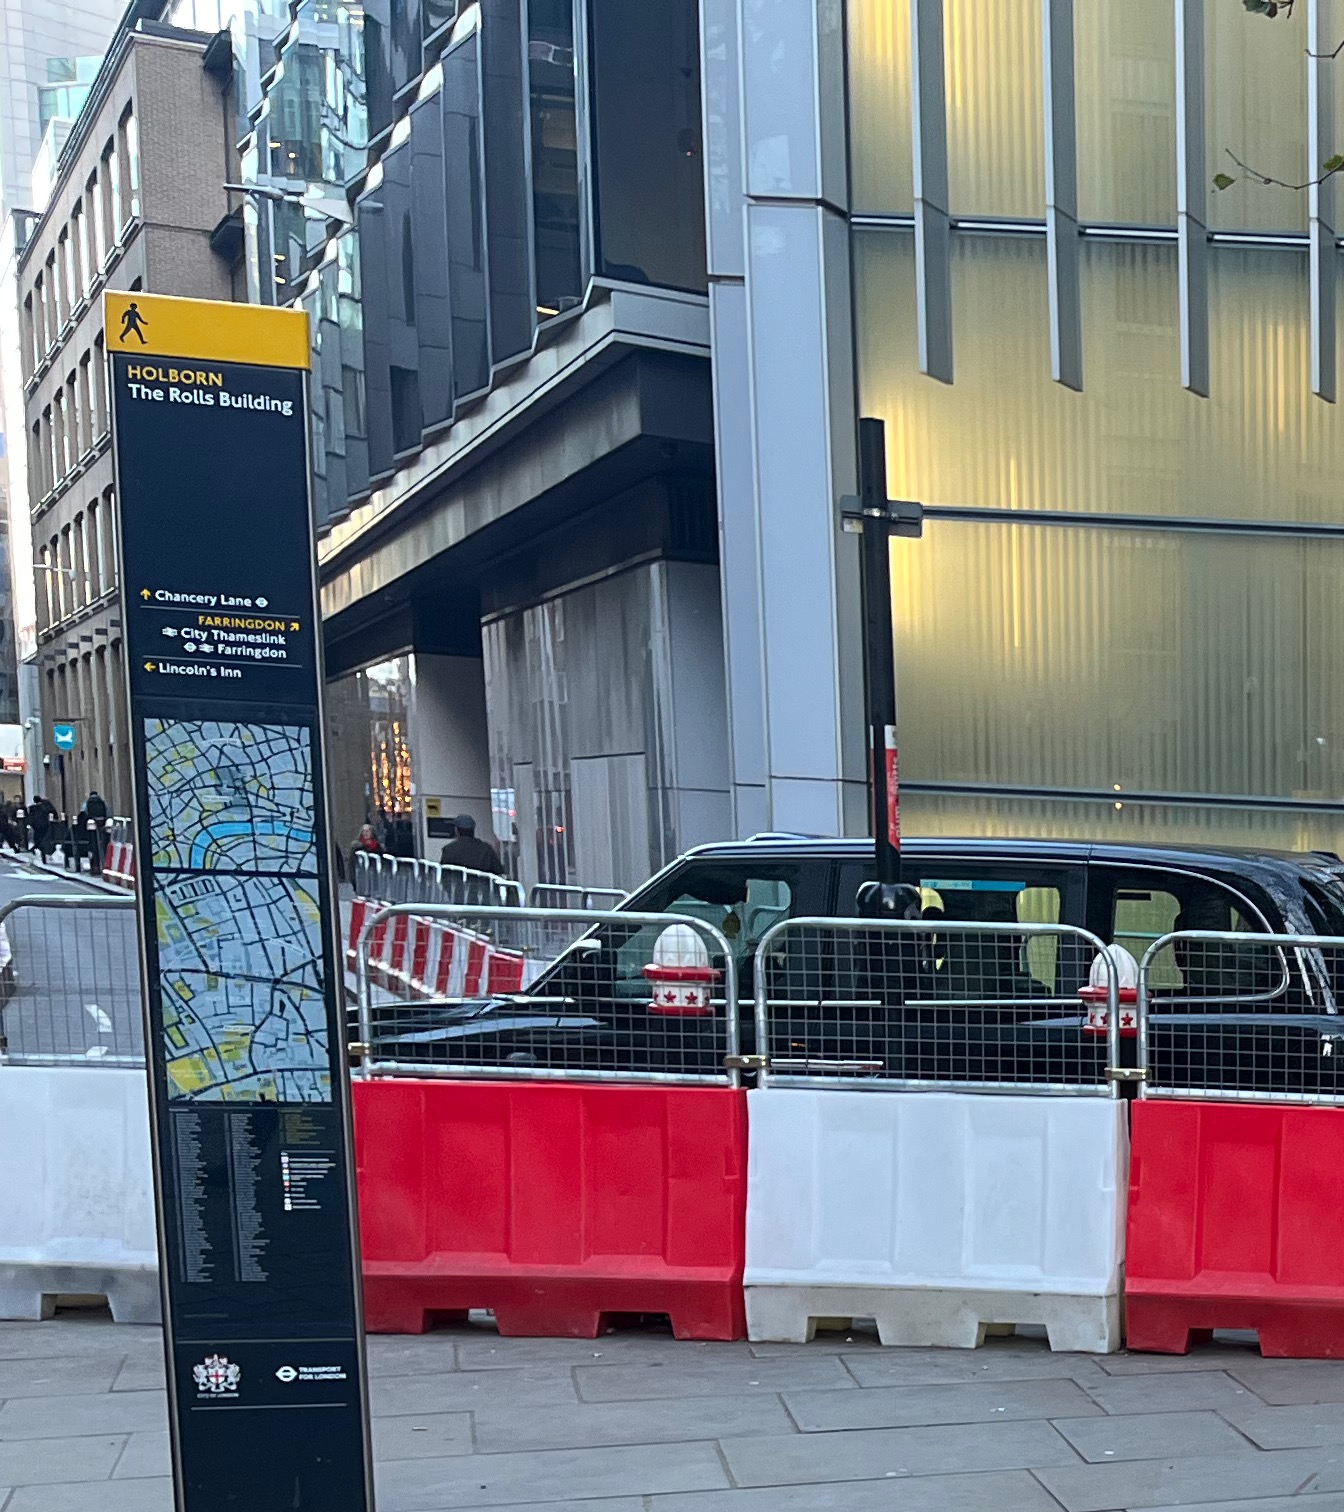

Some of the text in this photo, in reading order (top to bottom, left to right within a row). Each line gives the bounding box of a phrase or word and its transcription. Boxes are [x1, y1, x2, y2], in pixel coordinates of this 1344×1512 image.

[127, 364, 223, 387] HOLBORN
[128, 383, 293, 416] The Rolls Building
[155, 590, 252, 607] Chancery Lane
[198, 615, 285, 631] FARRINGDON
[180, 627, 286, 645] City Thameslink
[217, 644, 287, 659] Farringdon
[158, 662, 242, 678] Lincoln's Inn
